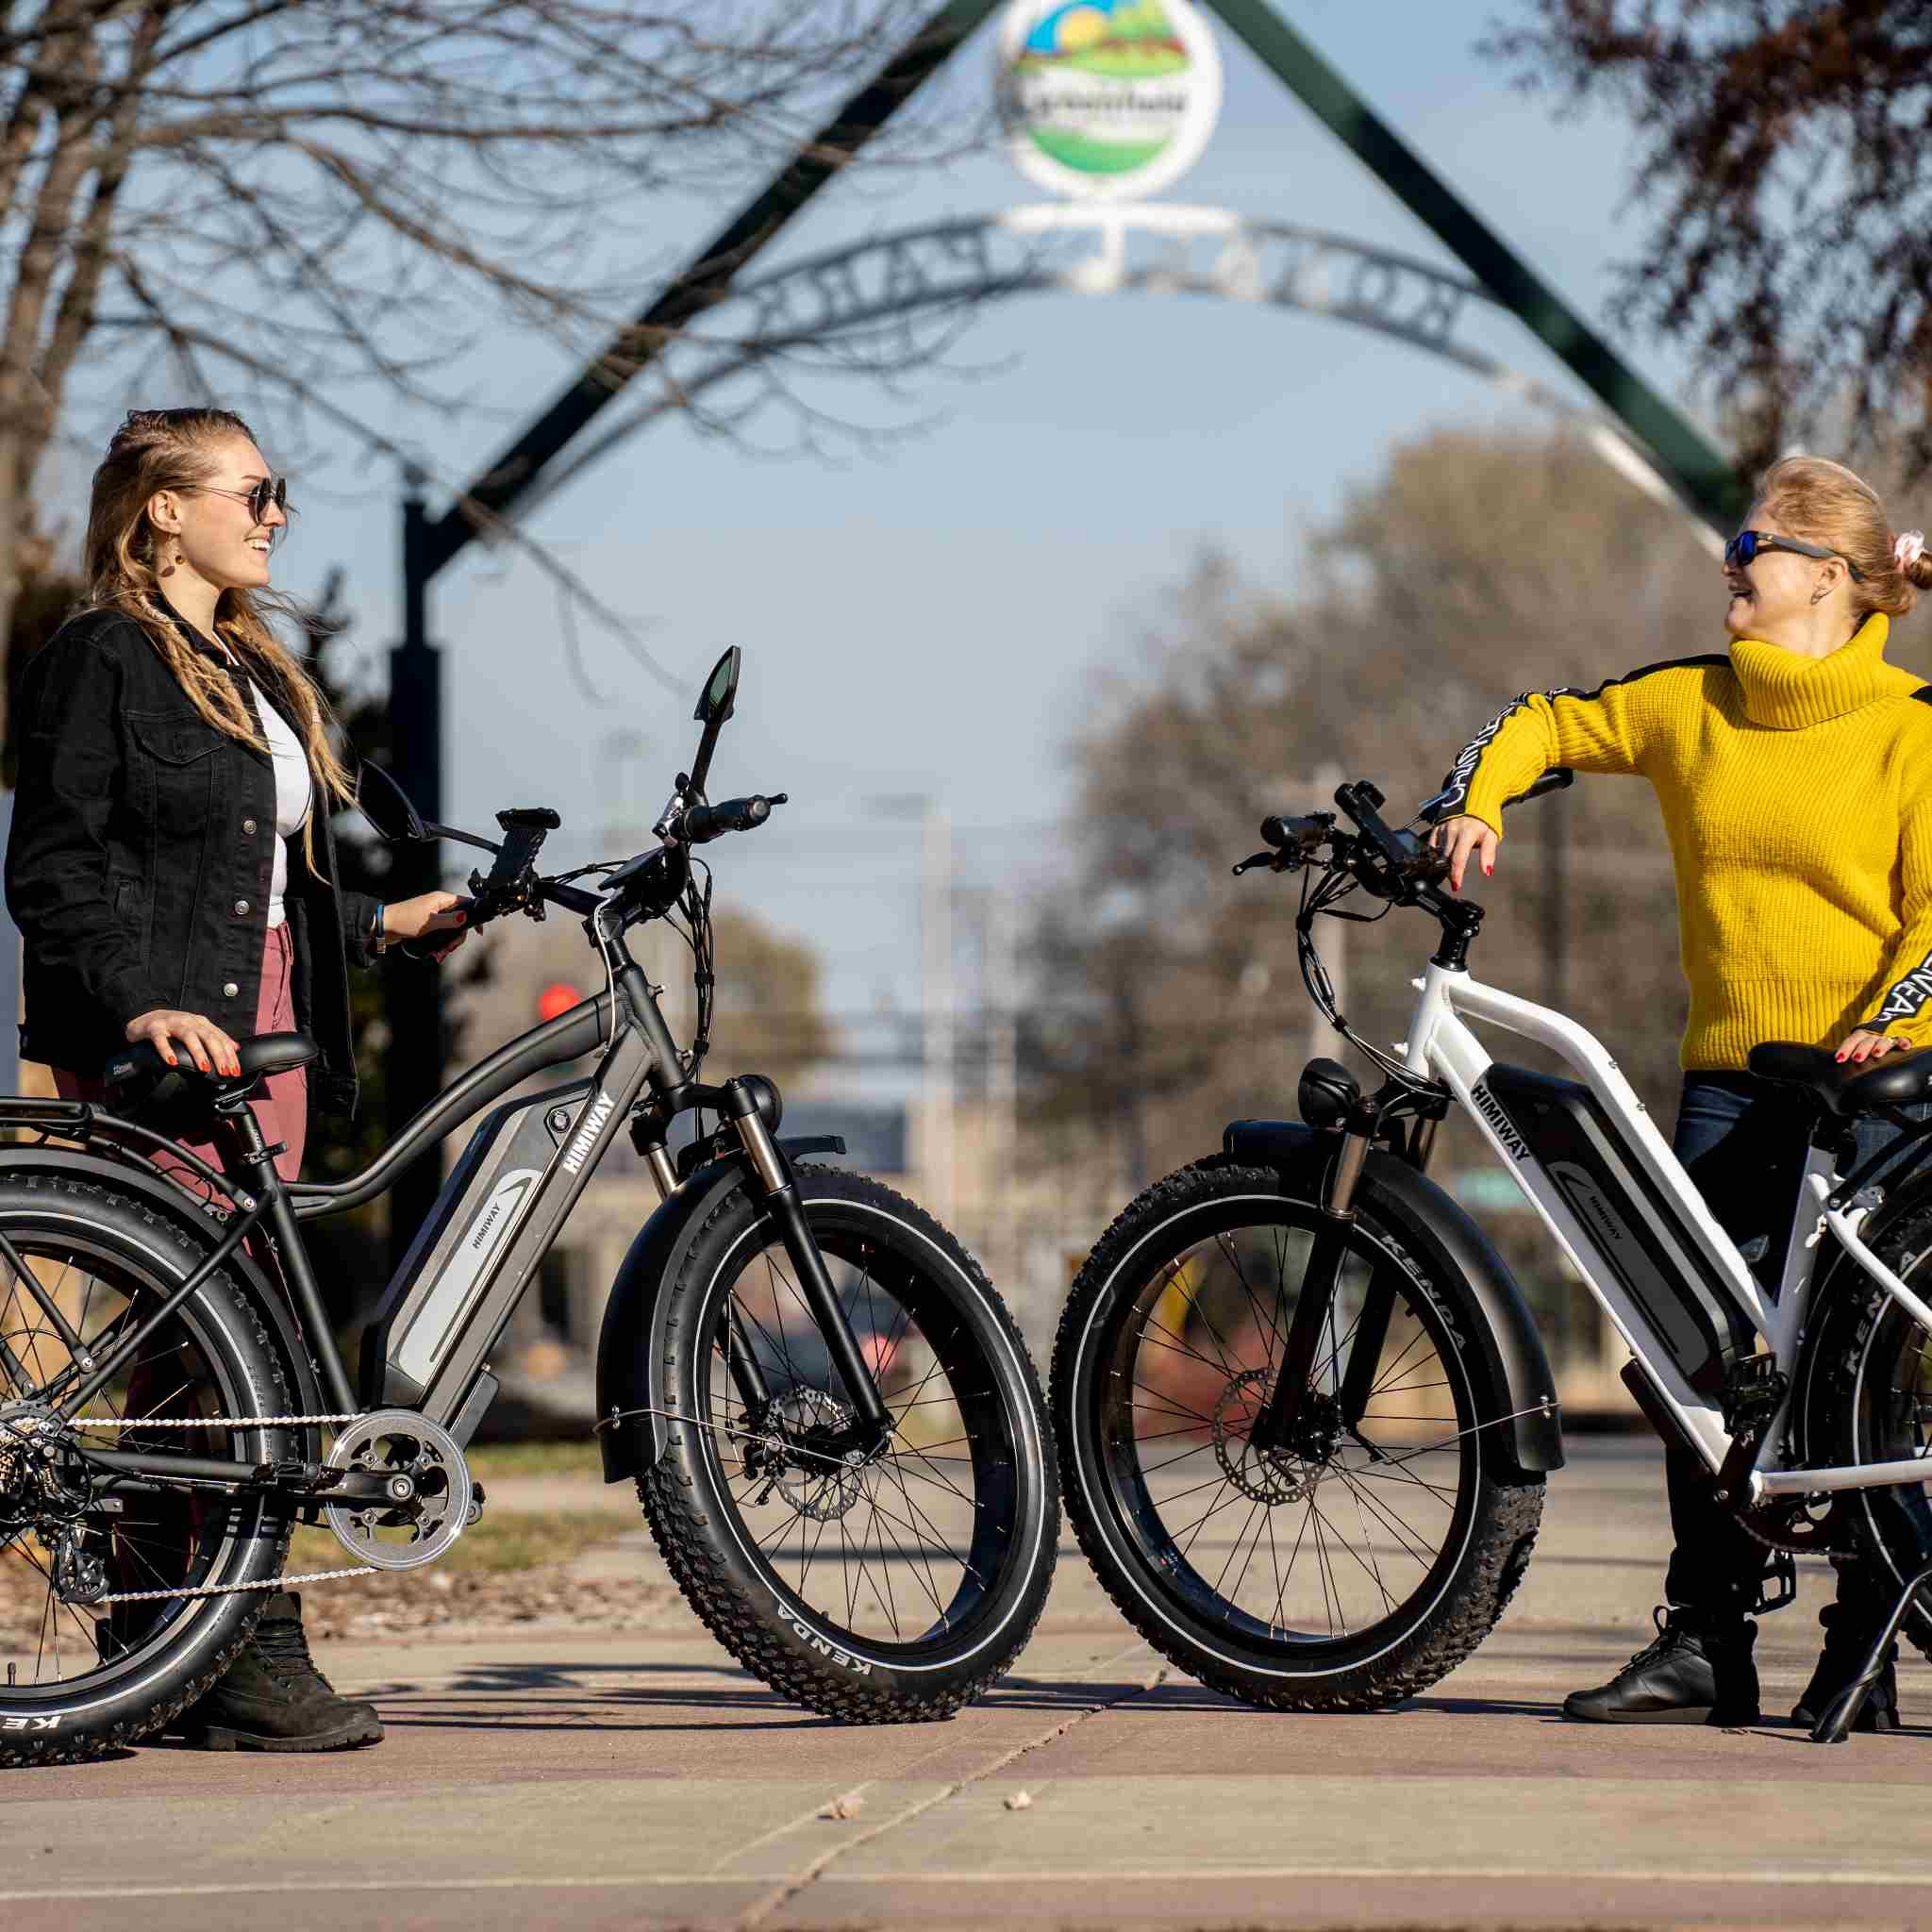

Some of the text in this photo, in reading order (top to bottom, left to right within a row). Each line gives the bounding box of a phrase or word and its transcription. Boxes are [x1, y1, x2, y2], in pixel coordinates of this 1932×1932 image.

[562, 1091, 617, 1174] HIMIWAY
[1472, 1084, 1532, 1161] HIMIWAY
[472, 1203, 502, 1250] HIMIWAY
[1380, 1235, 1467, 1350] KENDA
[1846, 1251, 1917, 1375] KENA
[777, 1604, 873, 1675] KENDA
[2, 1715, 61, 1731] KE
